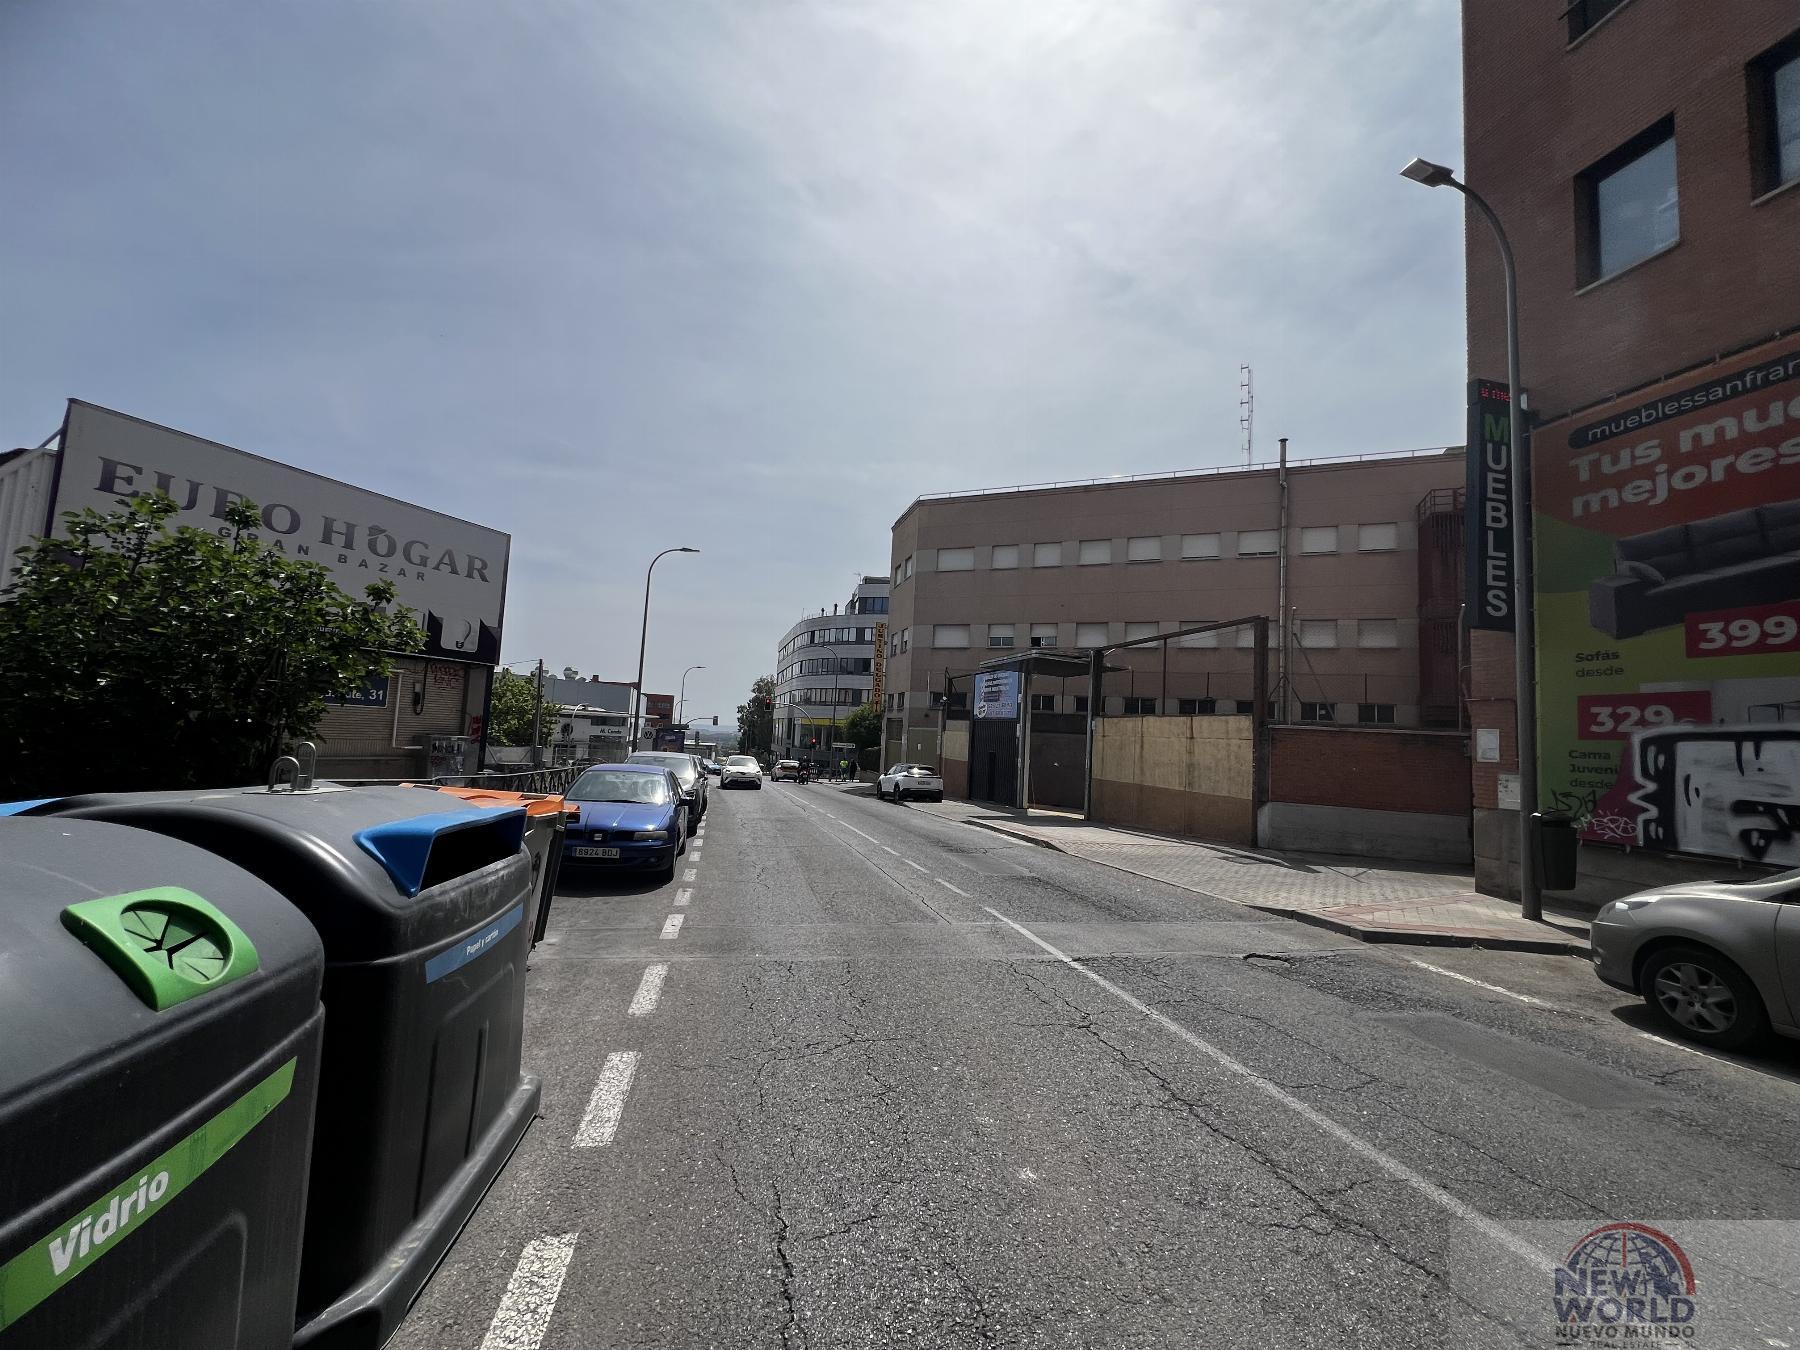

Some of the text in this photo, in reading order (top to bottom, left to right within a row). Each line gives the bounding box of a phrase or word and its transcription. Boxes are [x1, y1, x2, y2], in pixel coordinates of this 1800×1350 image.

[1568, 438, 1663, 482] Tus
[1484, 413, 1510, 617] MUEBLES
[319, 515, 491, 583] HOGAR
[337, 553, 426, 582] BAZAR
[1698, 615, 1798, 650] 399
[1575, 649, 1620, 663] Sofás
[1575, 665, 1625, 679] desde
[369, 689, 384, 701] 31
[1568, 749, 1612, 761] Cama
[1569, 777, 1615, 789] desde
[578, 848, 599, 857] 8924
[47, 1169, 169, 1276] Vidrio
